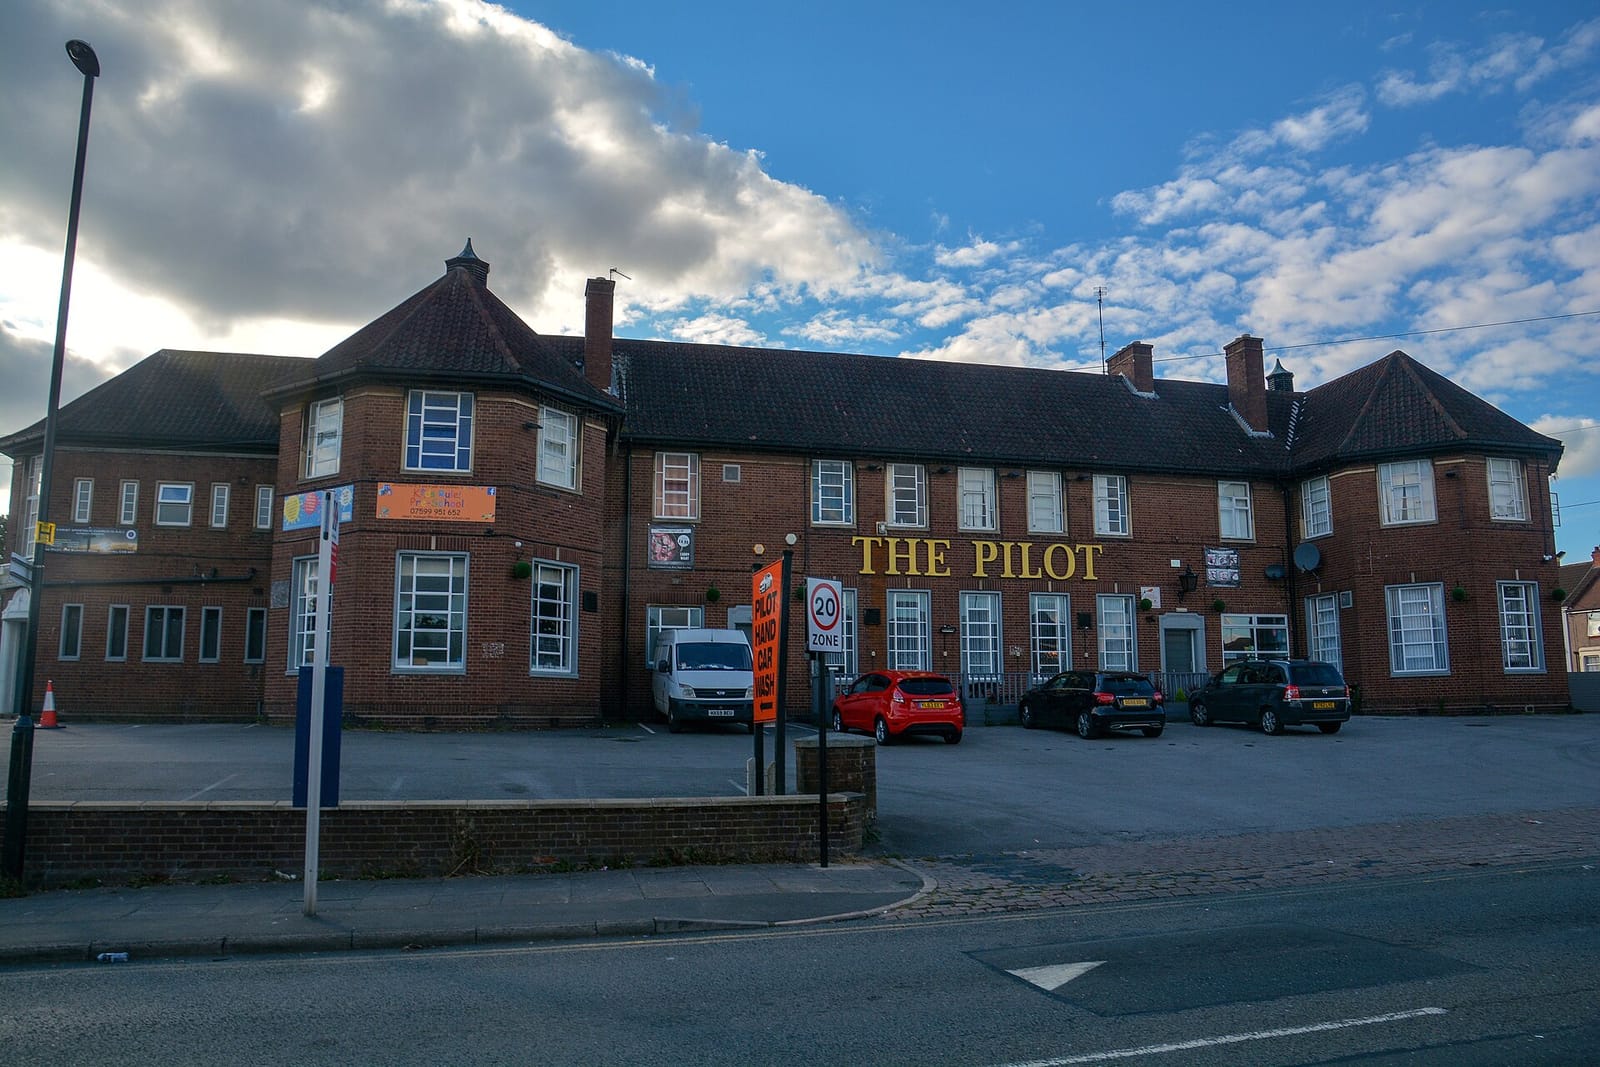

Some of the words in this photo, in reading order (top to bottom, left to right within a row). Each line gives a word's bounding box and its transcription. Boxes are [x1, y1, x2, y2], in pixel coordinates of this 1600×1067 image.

[410, 497, 465, 508] Pre-School
[413, 488, 435, 498] Kids
[447, 508, 461, 516] 652
[39, 524, 52, 543] H
[852, 536, 951, 577] THE
[971, 540, 1103, 580] PILOT
[755, 590, 777, 621] PILOT
[815, 596, 836, 617] 20
[755, 618, 776, 647] HAND
[812, 633, 839, 647] ZONE
[757, 646, 773, 672] CAR
[755, 672, 775, 698] WASH
